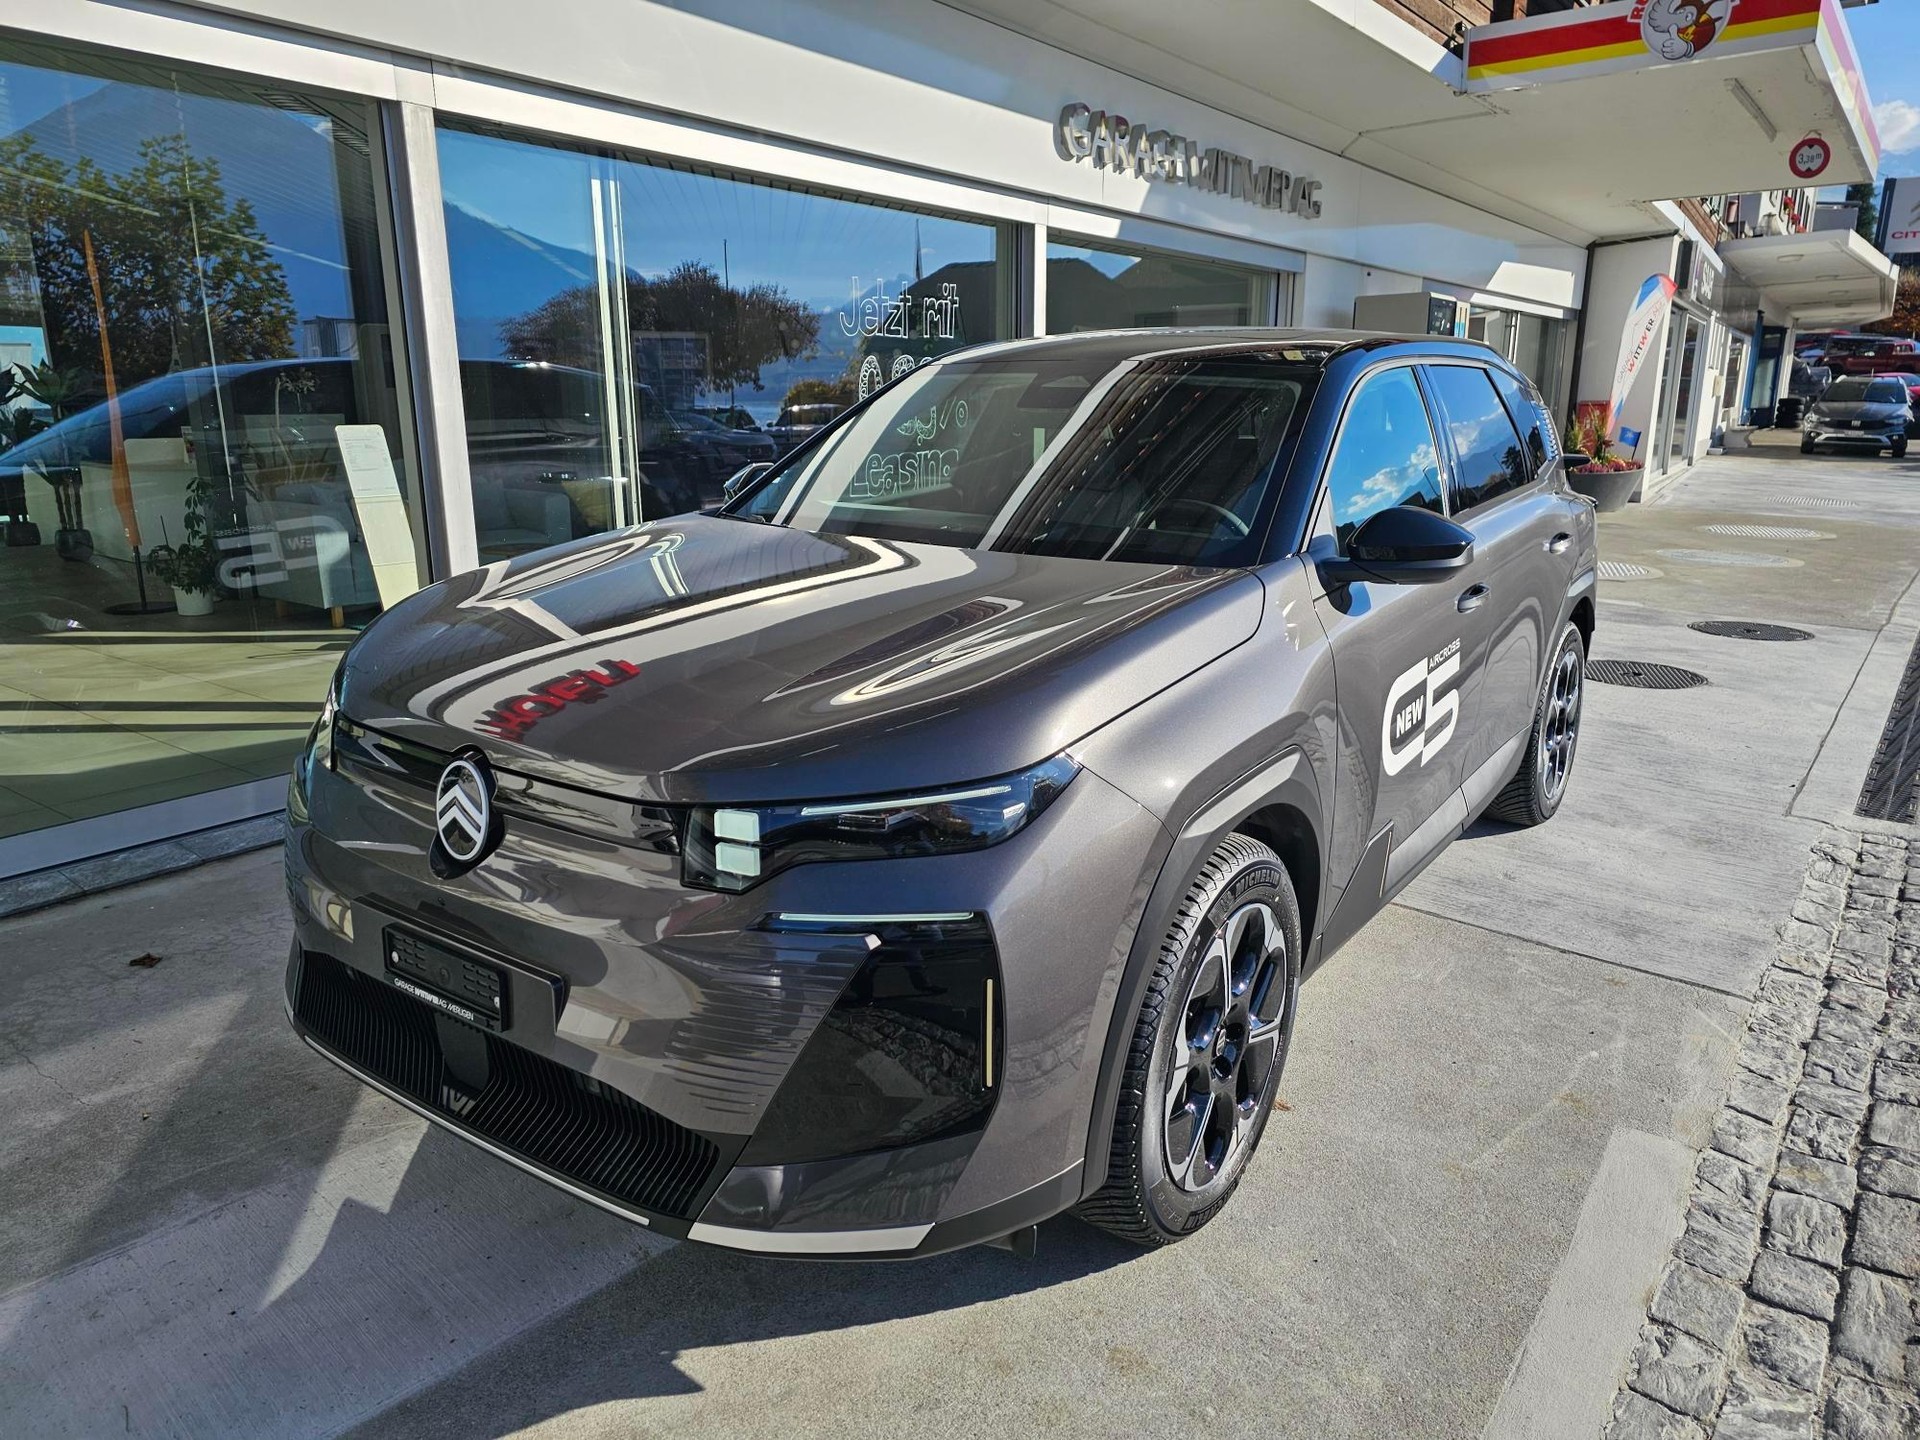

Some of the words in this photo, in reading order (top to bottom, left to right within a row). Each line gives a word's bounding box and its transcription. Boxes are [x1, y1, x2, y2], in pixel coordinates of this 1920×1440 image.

[839, 276, 911, 339] Jetzt
[923, 283, 959, 338] mit
[1627, 318, 1655, 373] WITTWER
[1428, 637, 1461, 670] AIRCROSS
[1382, 651, 1460, 776] C5
[1396, 695, 1424, 739] NEW
[1235, 869, 1281, 898] MICHELIN
[394, 977, 415, 994] GARAGE
